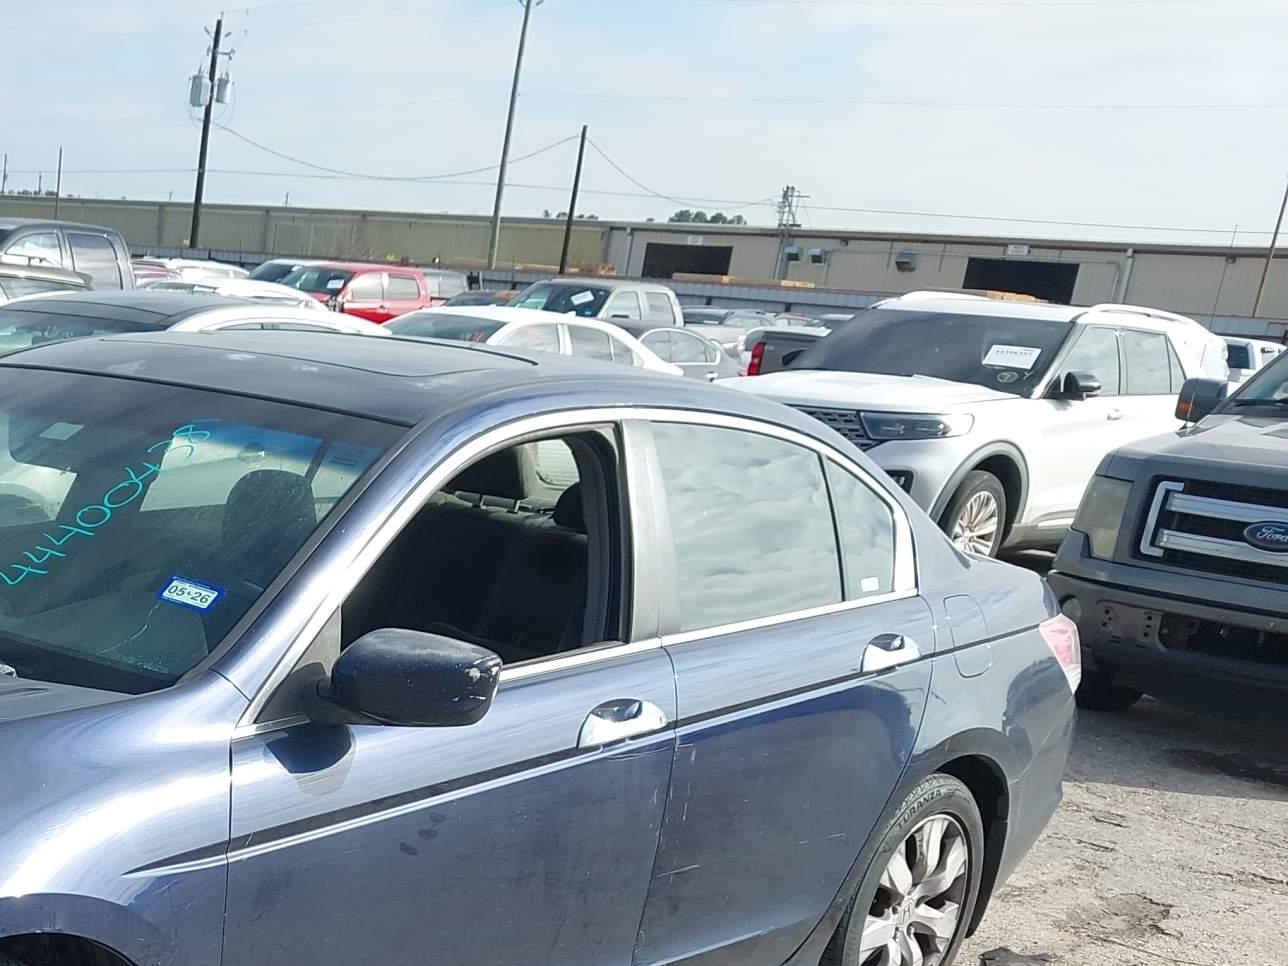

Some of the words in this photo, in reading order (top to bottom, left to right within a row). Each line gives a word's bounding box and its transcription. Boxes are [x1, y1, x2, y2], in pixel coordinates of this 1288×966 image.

[167, 585, 187, 596] 05
[190, 592, 211, 604] 26
[896, 788, 943, 830] TURANZA
